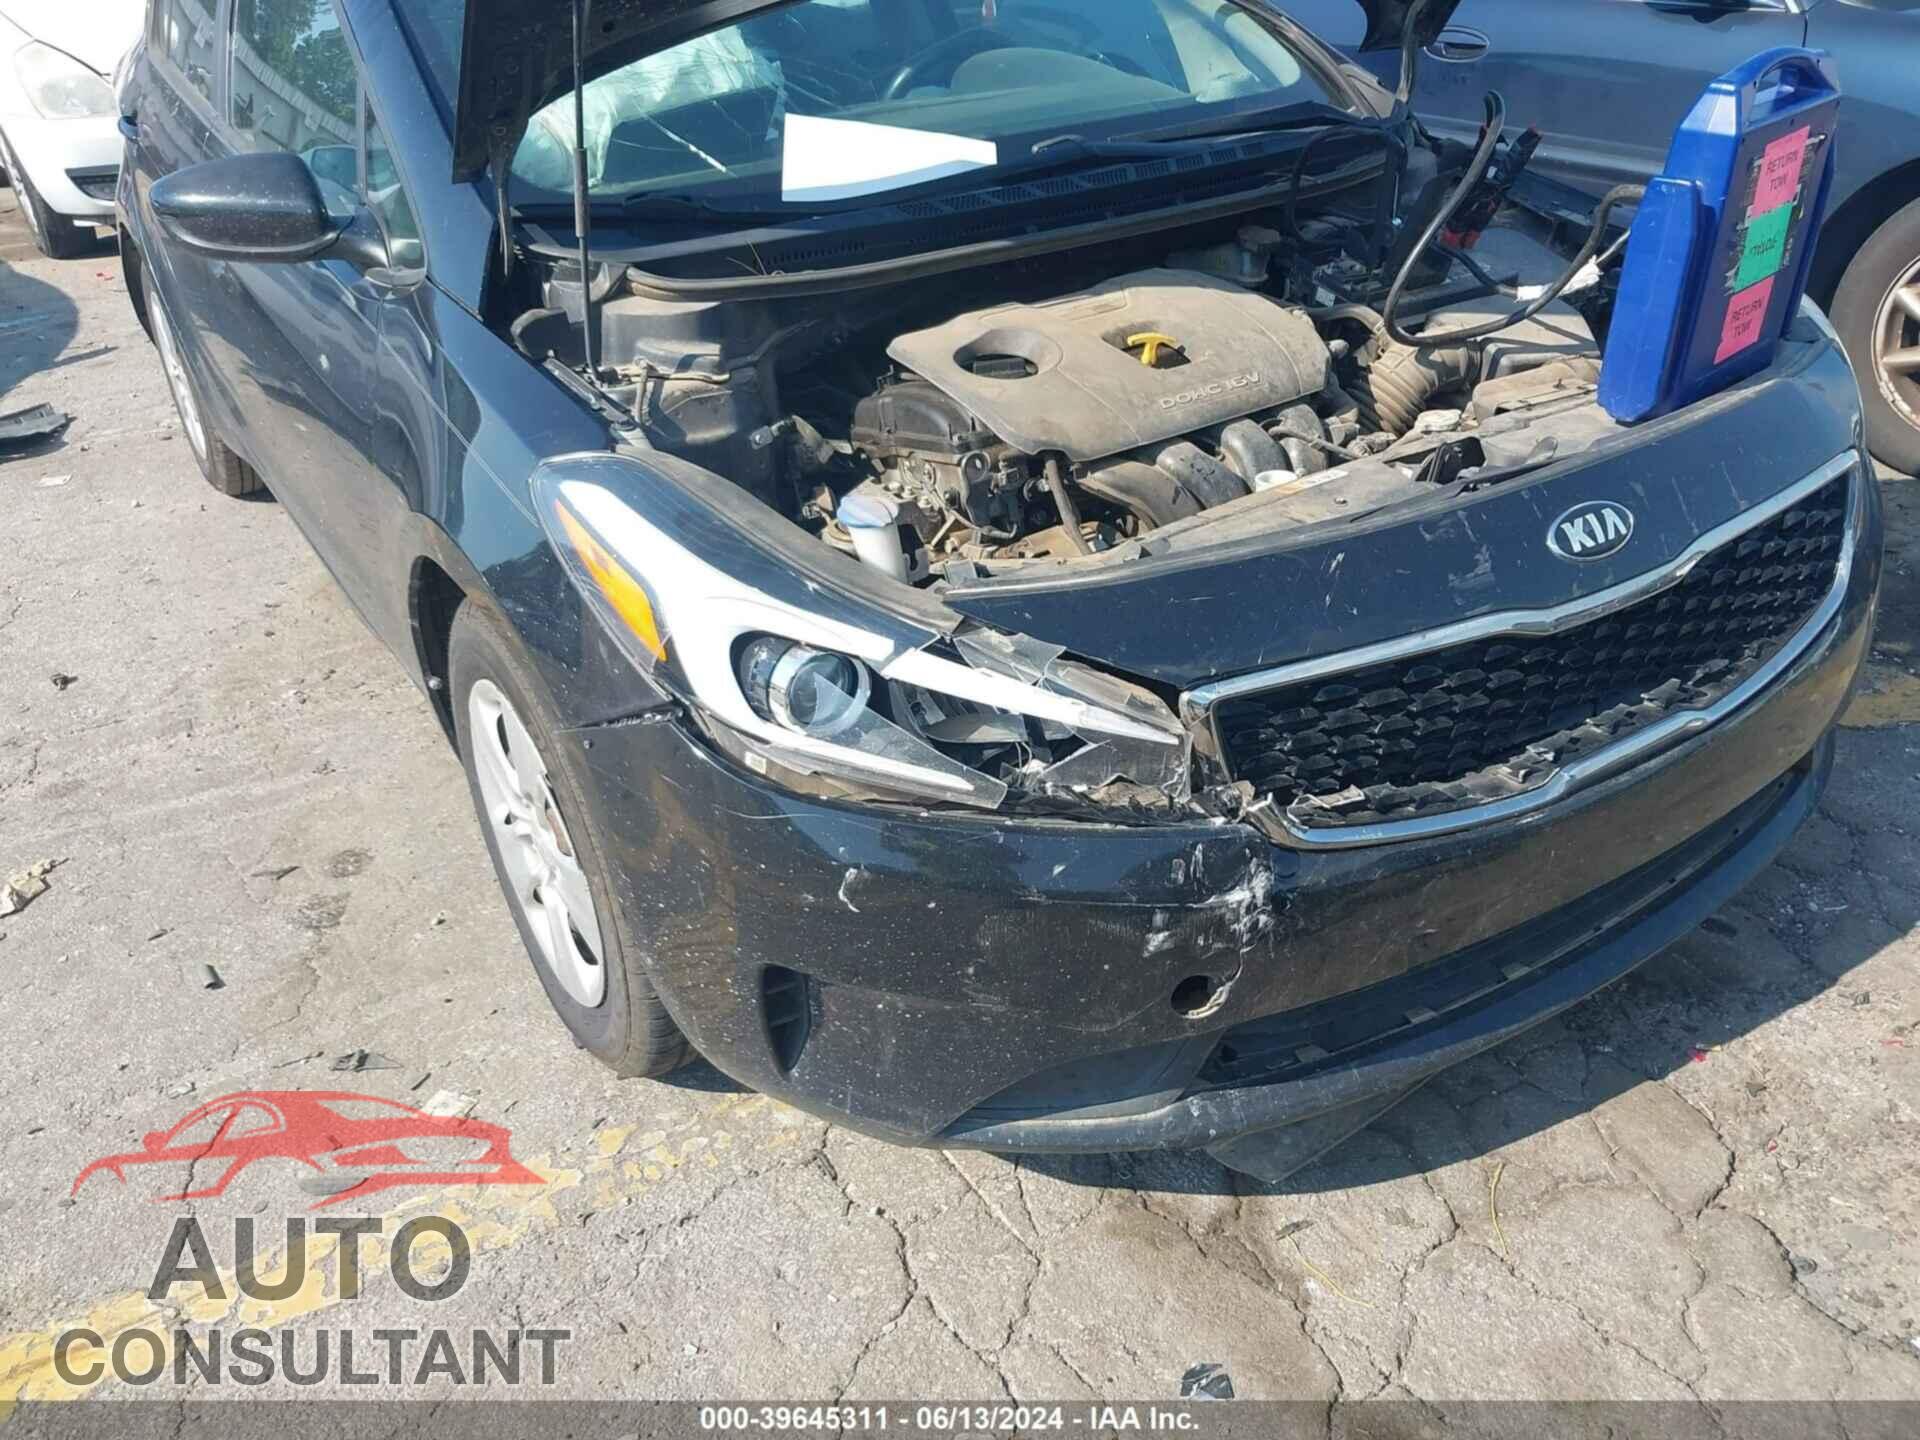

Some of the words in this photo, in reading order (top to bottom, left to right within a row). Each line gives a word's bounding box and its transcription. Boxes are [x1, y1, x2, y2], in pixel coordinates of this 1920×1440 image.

[1766, 151, 1798, 174] RETURN
[1731, 299, 1763, 321] RETURN
[1160, 384, 1222, 409] DOHC
[1225, 371, 1262, 391] 16V
[1560, 507, 1628, 553] KIA
